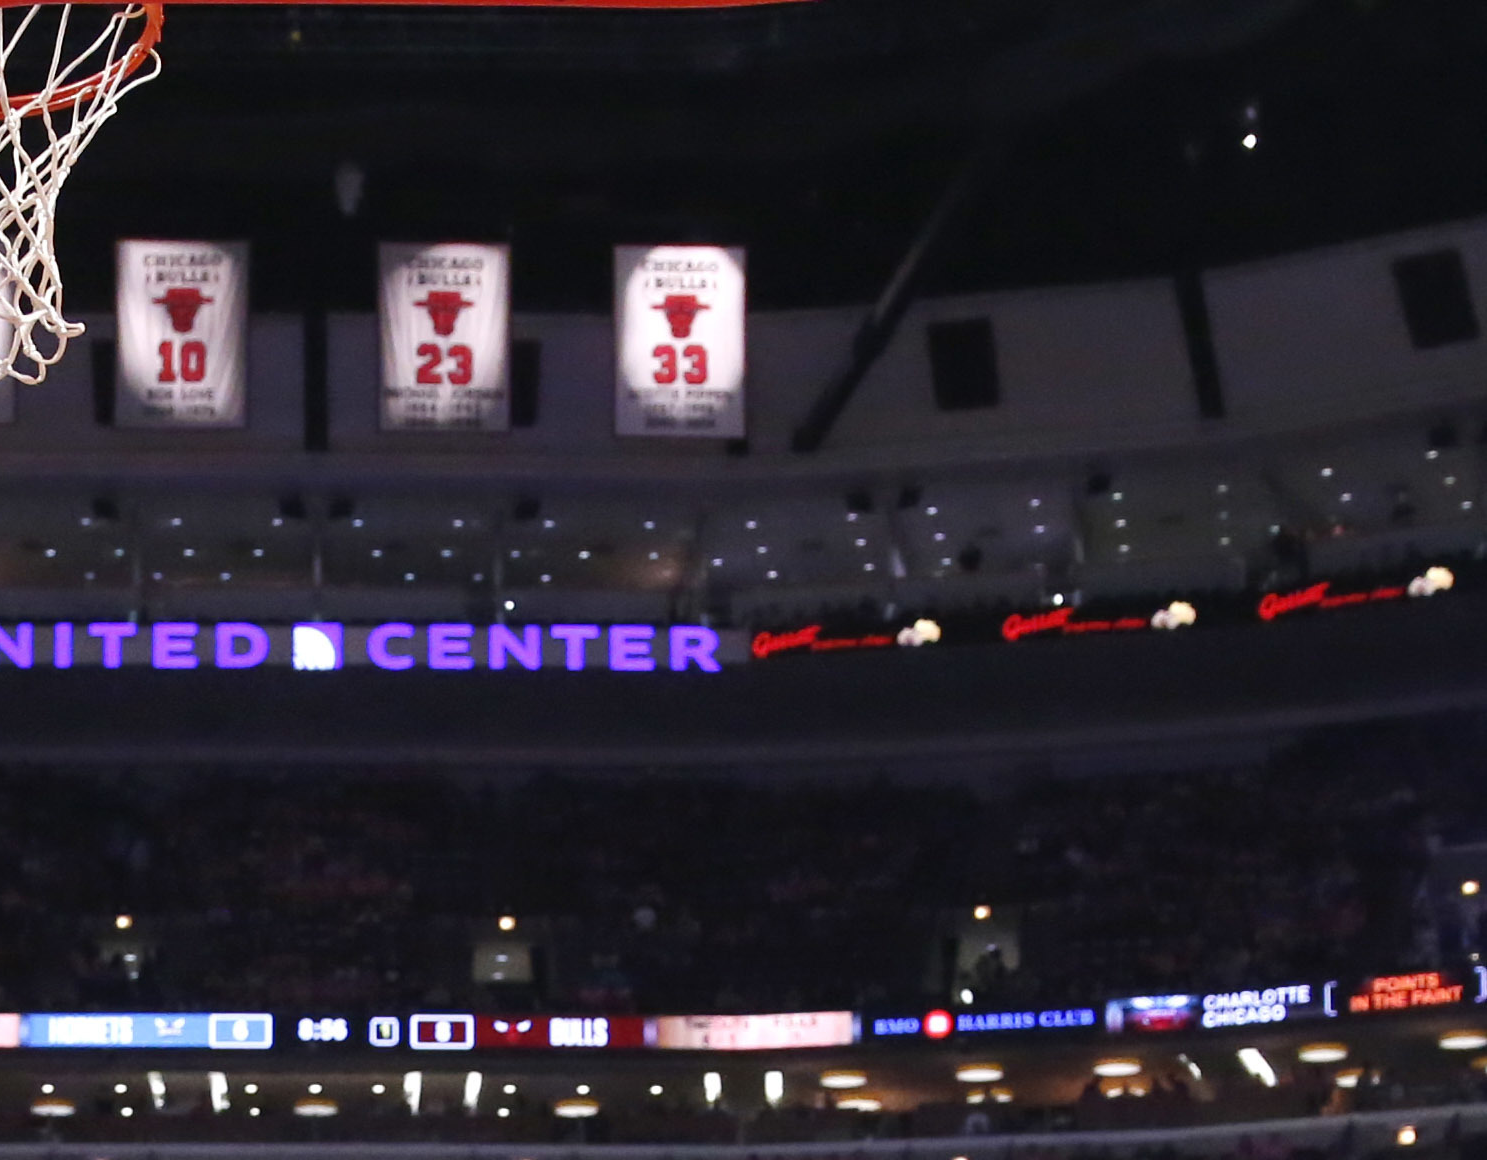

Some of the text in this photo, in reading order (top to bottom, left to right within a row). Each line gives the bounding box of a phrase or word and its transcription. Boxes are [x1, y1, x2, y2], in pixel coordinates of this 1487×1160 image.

[158, 341, 206, 382] 10
[416, 343, 473, 385] 23
[652, 345, 708, 385] 33
[366, 622, 721, 672] CENTER
[1372, 972, 1439, 992] POINTS
[1202, 985, 1311, 1011] CHARLOTTE
[1350, 985, 1463, 1012] IN THE PAINT
[874, 1008, 1095, 1036] BMO HARRIS CLUB
[1202, 1004, 1286, 1028] CHICAGO
